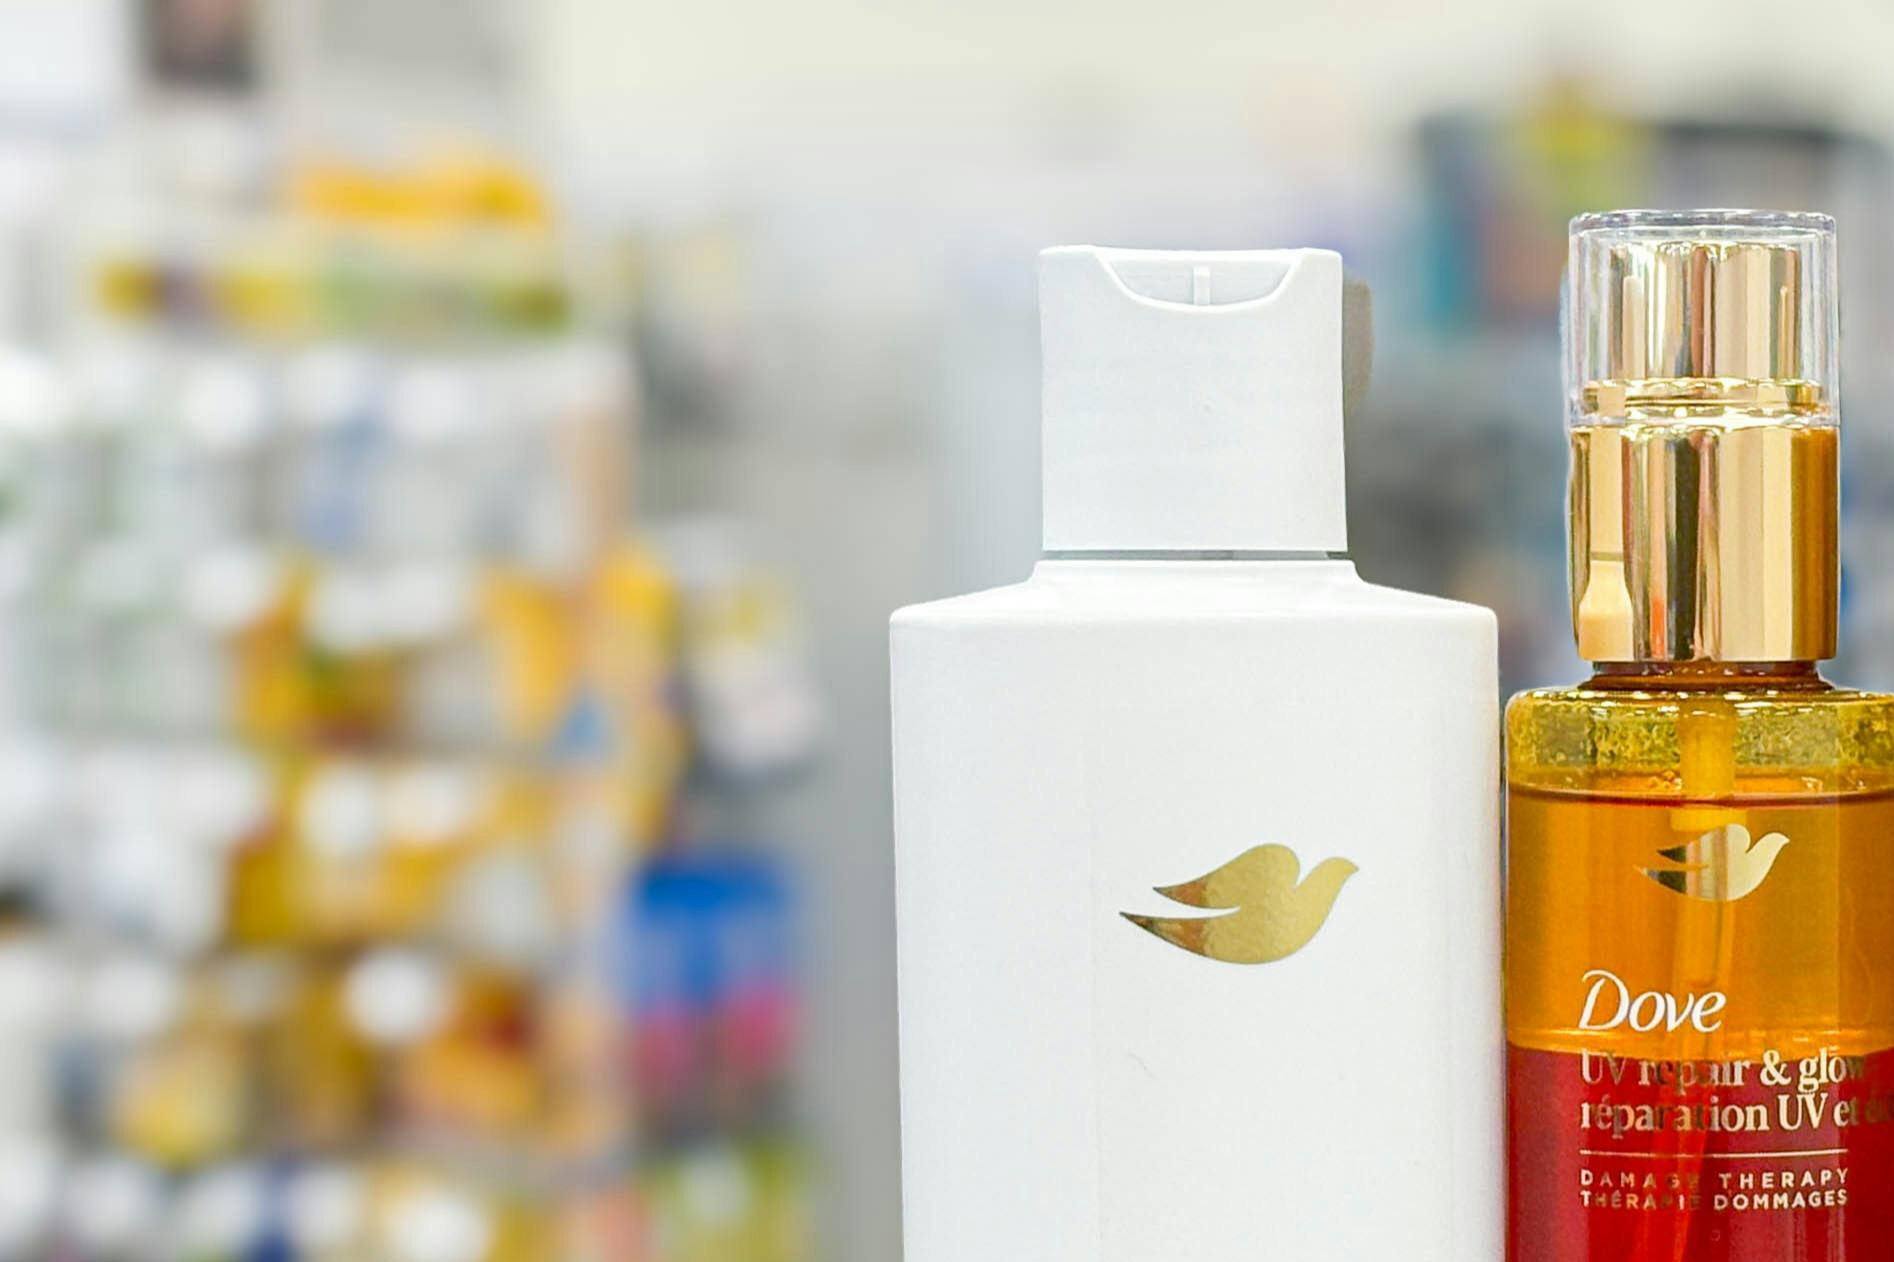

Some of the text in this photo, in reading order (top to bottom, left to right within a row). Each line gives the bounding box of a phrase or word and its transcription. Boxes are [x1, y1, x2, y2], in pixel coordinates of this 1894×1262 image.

[1578, 969, 1727, 1033] Dove
[1580, 1048, 1627, 1086] UV
[1759, 1049, 1792, 1086] &
[1778, 1092, 1829, 1130] UV
[1718, 1168, 1848, 1190] THERAPY
[1713, 1189, 1848, 1211] DOMMAGES
